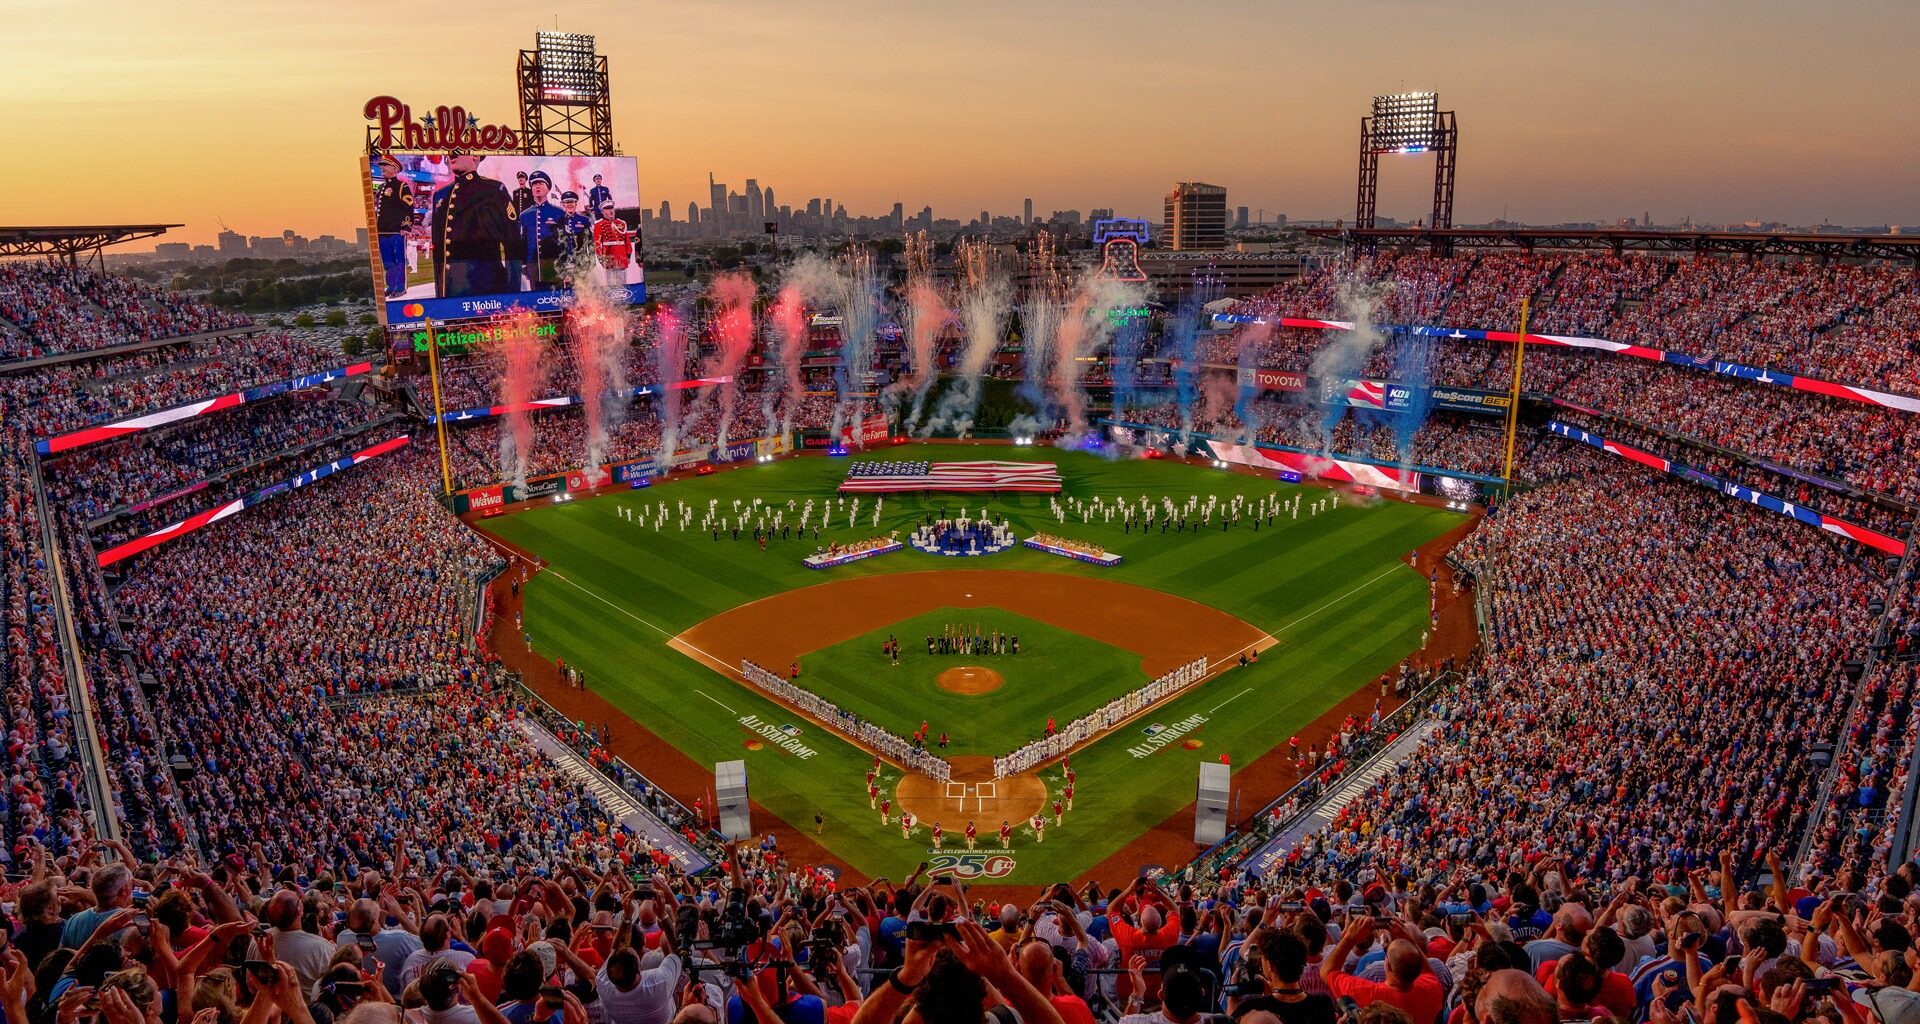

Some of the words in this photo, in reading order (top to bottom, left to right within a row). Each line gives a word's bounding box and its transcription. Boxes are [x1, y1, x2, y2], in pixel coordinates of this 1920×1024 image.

[363, 95, 519, 150] Phillies
[472, 300, 502, 312] Mobile
[537, 295, 572, 304] abbvie
[436, 331, 491, 346] Citizens
[494, 325, 526, 341] Bank
[529, 322, 557, 337] Park
[1258, 374, 1302, 388] TOYOTA
[1432, 390, 1483, 403] theScore
[1485, 397, 1509, 406] BET
[805, 438, 832, 446] GIANT
[630, 469, 657, 479] WILLIAMS
[526, 481, 558, 494] NovaCare
[471, 495, 502, 508] Wawa
[1171, 713, 1210, 733] GAME
[780, 738, 818, 760] GAME
